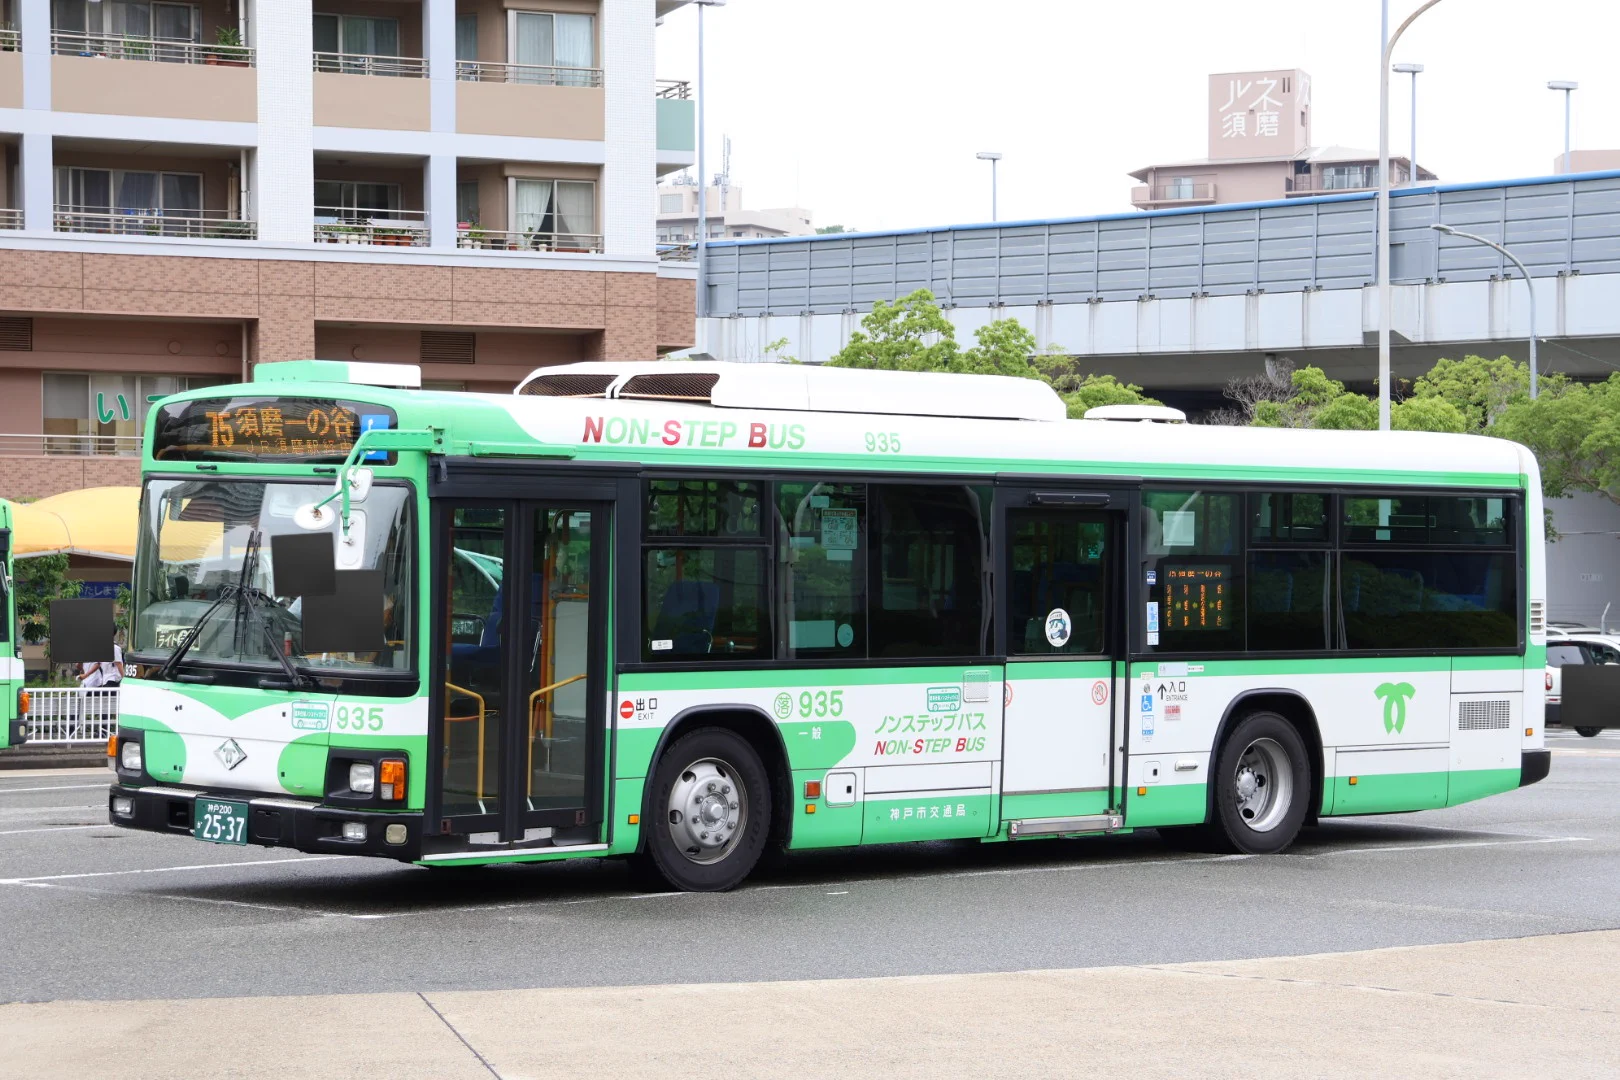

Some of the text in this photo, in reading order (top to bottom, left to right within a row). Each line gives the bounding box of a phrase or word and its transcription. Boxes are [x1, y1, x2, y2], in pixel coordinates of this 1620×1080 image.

[1219, 77, 1283, 112] ルネ
[1222, 111, 1279, 138] 須磨
[205, 406, 354, 447] 75 須磨一の谷
[583, 416, 805, 449] NON-STEP BUS
[865, 432, 901, 452] 935
[1169, 681, 1185, 693] 入口
[635, 697, 657, 711] 出口
[799, 690, 843, 718] 935
[1166, 694, 1188, 702] ENTRANCE
[337, 706, 384, 731] 935
[638, 712, 654, 720] EXIT
[874, 712, 986, 734] ノンステップバス
[798, 726, 821, 740] 一般
[874, 736, 986, 756] NON-STEP BUS
[889, 803, 966, 821] 神戸市交通局
